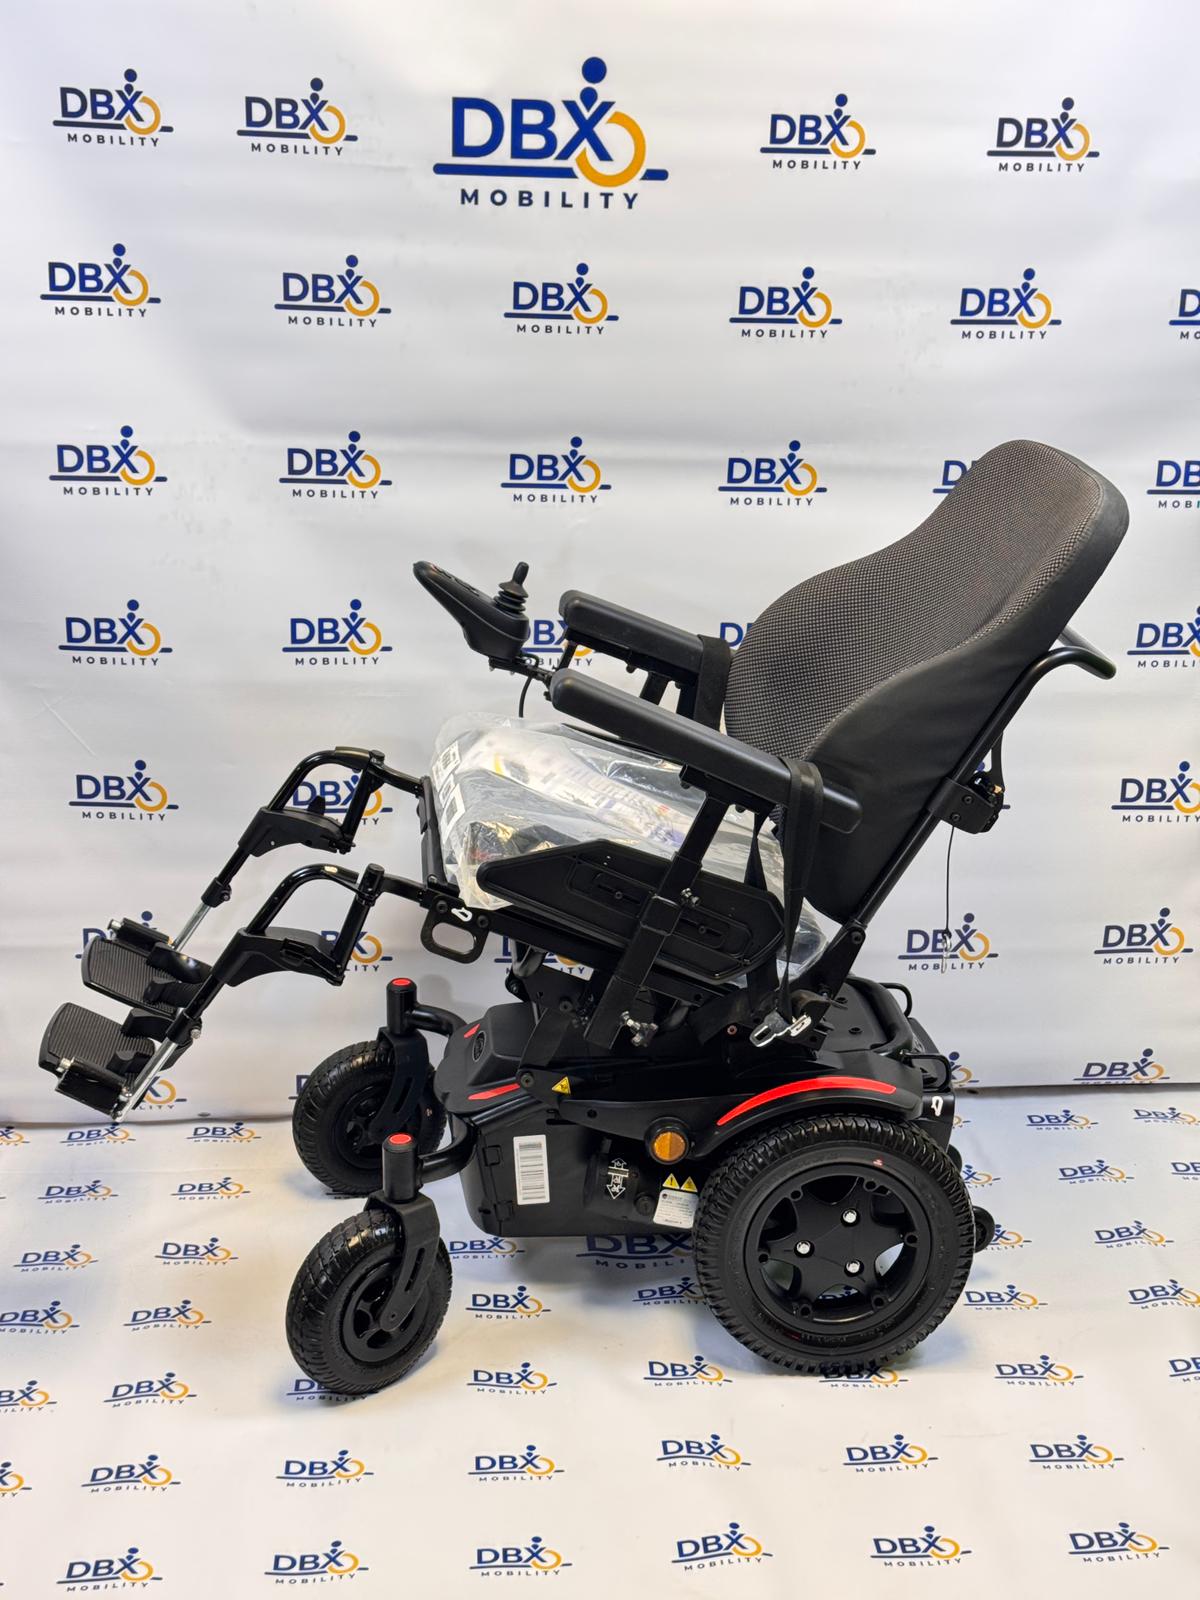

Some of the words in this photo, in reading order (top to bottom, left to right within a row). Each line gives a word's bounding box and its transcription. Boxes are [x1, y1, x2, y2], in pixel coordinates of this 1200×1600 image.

[60, 87, 144, 122] DBX
[245, 96, 329, 131] DBX
[452, 97, 615, 162] DBX
[769, 114, 851, 146] DBX
[996, 117, 1077, 149] DBX
[67, 133, 159, 147] MOBILITY
[251, 143, 343, 156] MOBILITY
[772, 160, 861, 170] MOBILITY
[998, 162, 1084, 172] MOBILITY
[461, 188, 638, 209] MOBILITY
[48, 262, 132, 294] DBX
[283, 272, 363, 304] DBX
[513, 281, 592, 312] DBX
[738, 286, 818, 316] DBX
[959, 288, 1038, 317] DBX
[55, 306, 146, 317] MOBILITY
[288, 316, 377, 327] MOBILITY
[517, 324, 604, 335] MOBILITY
[741, 329, 827, 338] MOBILITY
[962, 330, 1047, 339] MOBILITY
[57, 444, 139, 474] DBX
[287, 448, 365, 477] DBX
[509, 453, 586, 481] DBX
[727, 457, 803, 485] DBX
[1156, 460, 1200, 487] DB
[63, 487, 153, 496] MOBILITY
[292, 489, 378, 499] MOBILITY
[513, 494, 597, 503] MOBILITY
[730, 497, 813, 506] MOBILITY
[65, 617, 145, 645] DBX
[290, 618, 366, 645] DBX
[72, 656, 158, 666] MOBILITY
[295, 657, 379, 666] MOBILITY
[1137, 660, 1196, 668] MOBILI
[76, 774, 153, 801] DBX
[1120, 778, 1193, 803] DBX
[82, 811, 165, 821] MOBILITY
[1102, 923, 1172, 948] DBX
[1082, 1061, 1154, 1077] DBX
[67, 1128, 119, 1140] DBX
[193, 1126, 244, 1137] DBX
[45, 1185, 102, 1196] DBX
[178, 1181, 232, 1193] DBX
[1095, 1226, 1152, 1241] DBX
[162, 1242, 220, 1257] DBX
[449, 1239, 505, 1251] DBX
[21, 1251, 80, 1264] DBX
[595, 1259, 685, 1269] MOBILI
[638, 1282, 696, 1299] DBX
[965, 1289, 1022, 1303] DBX
[1128, 1284, 1190, 1301] DBX
[472, 1294, 530, 1309] DBX
[131, 1307, 192, 1322] DBX
[648, 1361, 710, 1377] DBX
[996, 1363, 1059, 1376] DBX
[473, 1370, 534, 1385] DBX
[0, 1388, 39, 1402] BX
[112, 1380, 176, 1398] DBX
[662, 1440, 727, 1458] DBX
[846, 1443, 913, 1461] DBX
[1030, 1444, 1099, 1458] DBX
[284, 1458, 351, 1476] DBX
[475, 1455, 540, 1471] DBX
[90, 1464, 159, 1482] DBX
[677, 1533, 747, 1558] DBX
[873, 1536, 945, 1554] DBX
[1069, 1531, 1141, 1550] DBX
[273, 1550, 344, 1571] DBX
[477, 1547, 546, 1564] DBX
[66, 1558, 140, 1579] DBX
